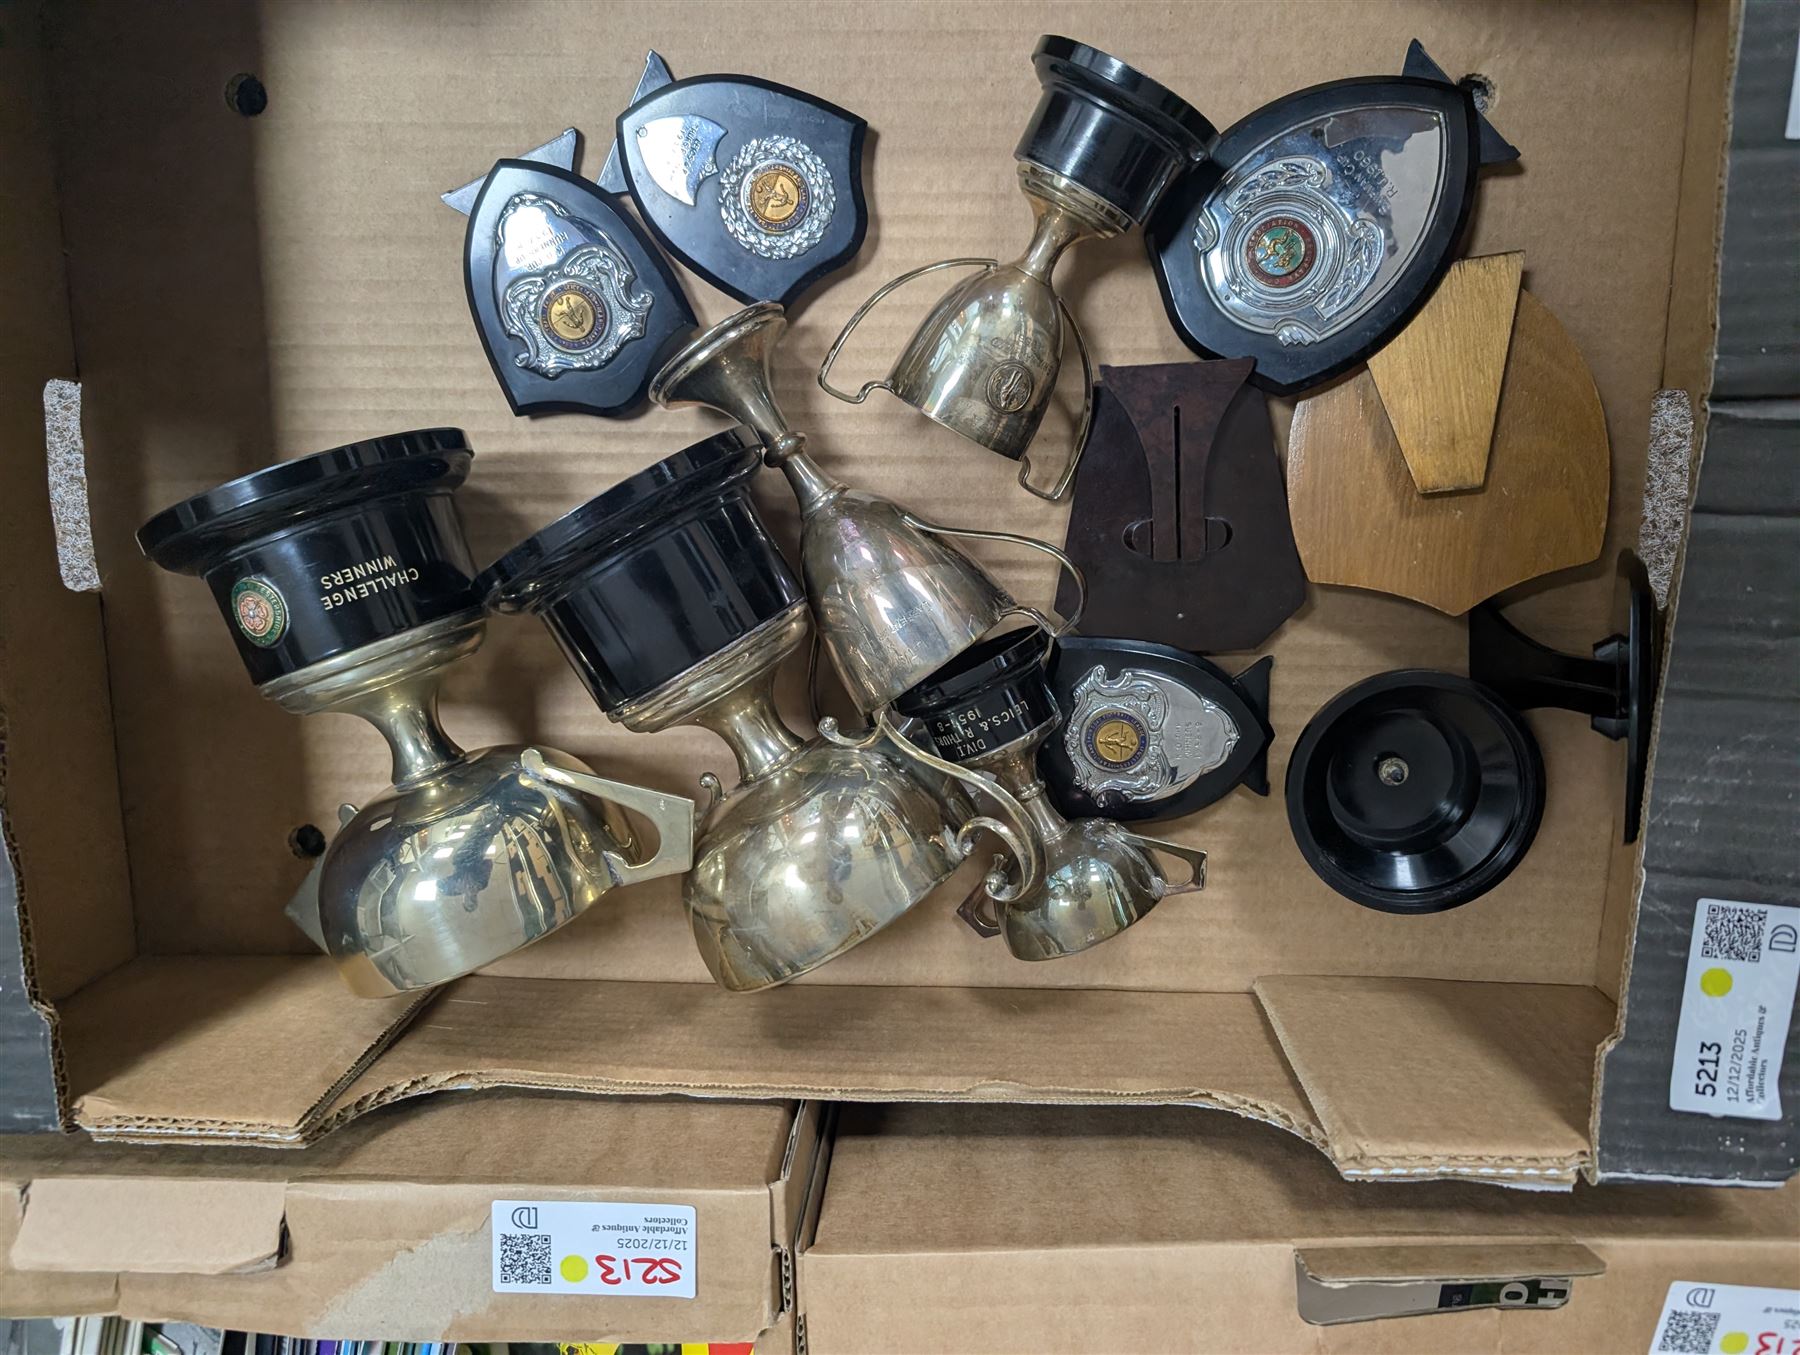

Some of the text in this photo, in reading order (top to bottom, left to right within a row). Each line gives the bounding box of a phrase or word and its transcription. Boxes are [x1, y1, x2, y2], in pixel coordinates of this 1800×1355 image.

[320, 555, 398, 590] WINNERS
[320, 567, 420, 611] CHALLENGE
[936, 707, 982, 733] 195-8
[1751, 1016, 1765, 1055] Antiques
[1694, 1041, 1722, 1098] 5213
[1726, 1029, 1748, 1103] 12/12/2025
[1745, 1056, 1758, 1103] Affordable
[601, 1224, 641, 1234] Antiques
[642, 1226, 688, 1235] Affordable
[644, 1217, 688, 1226] Collectors
[616, 1238, 688, 1251] 12/12/2025
[595, 1254, 683, 1286] 5213
